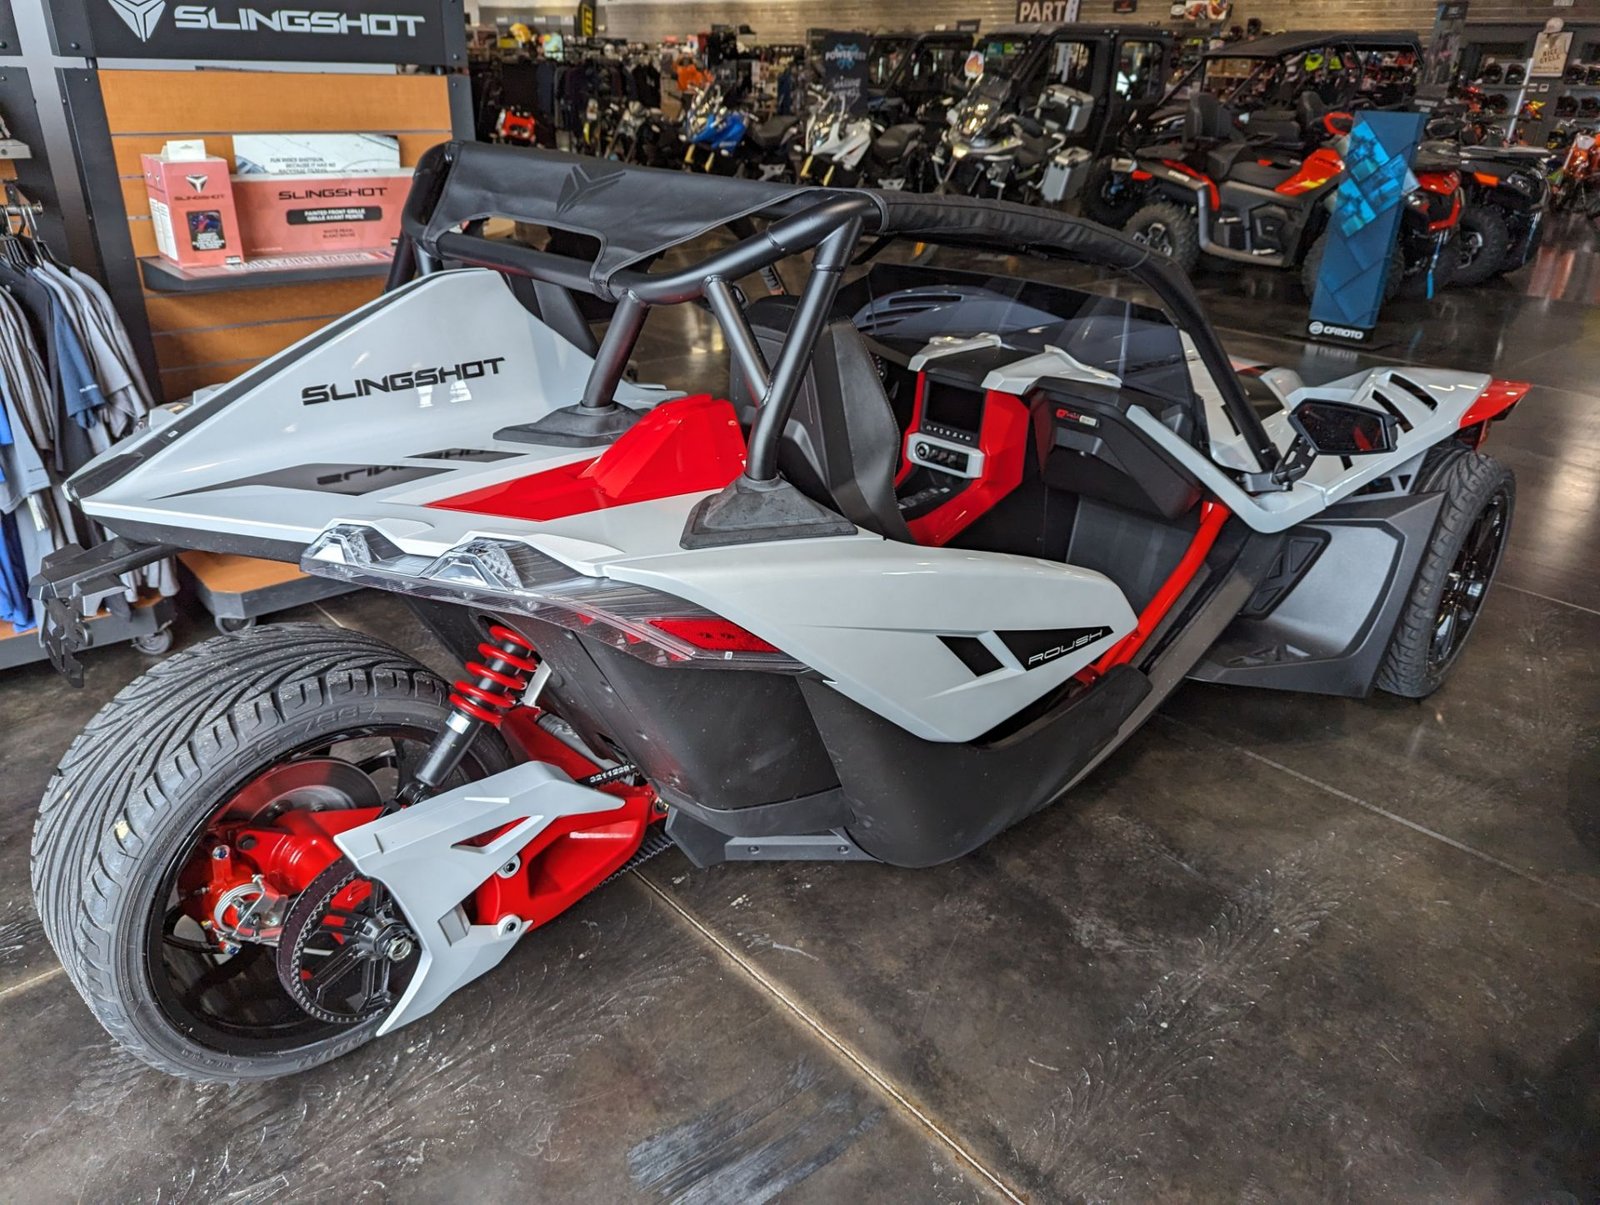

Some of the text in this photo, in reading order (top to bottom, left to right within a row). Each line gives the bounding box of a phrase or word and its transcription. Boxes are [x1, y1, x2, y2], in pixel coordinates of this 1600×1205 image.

[174, 6, 425, 37] SLINGSHOT
[1019, 1, 1074, 22] PART
[279, 187, 388, 200] SLINGSHOT
[1323, 325, 1365, 340] CFMOTO
[302, 356, 506, 406] SLINGSHOT
[1027, 629, 1103, 666] ROUSH
